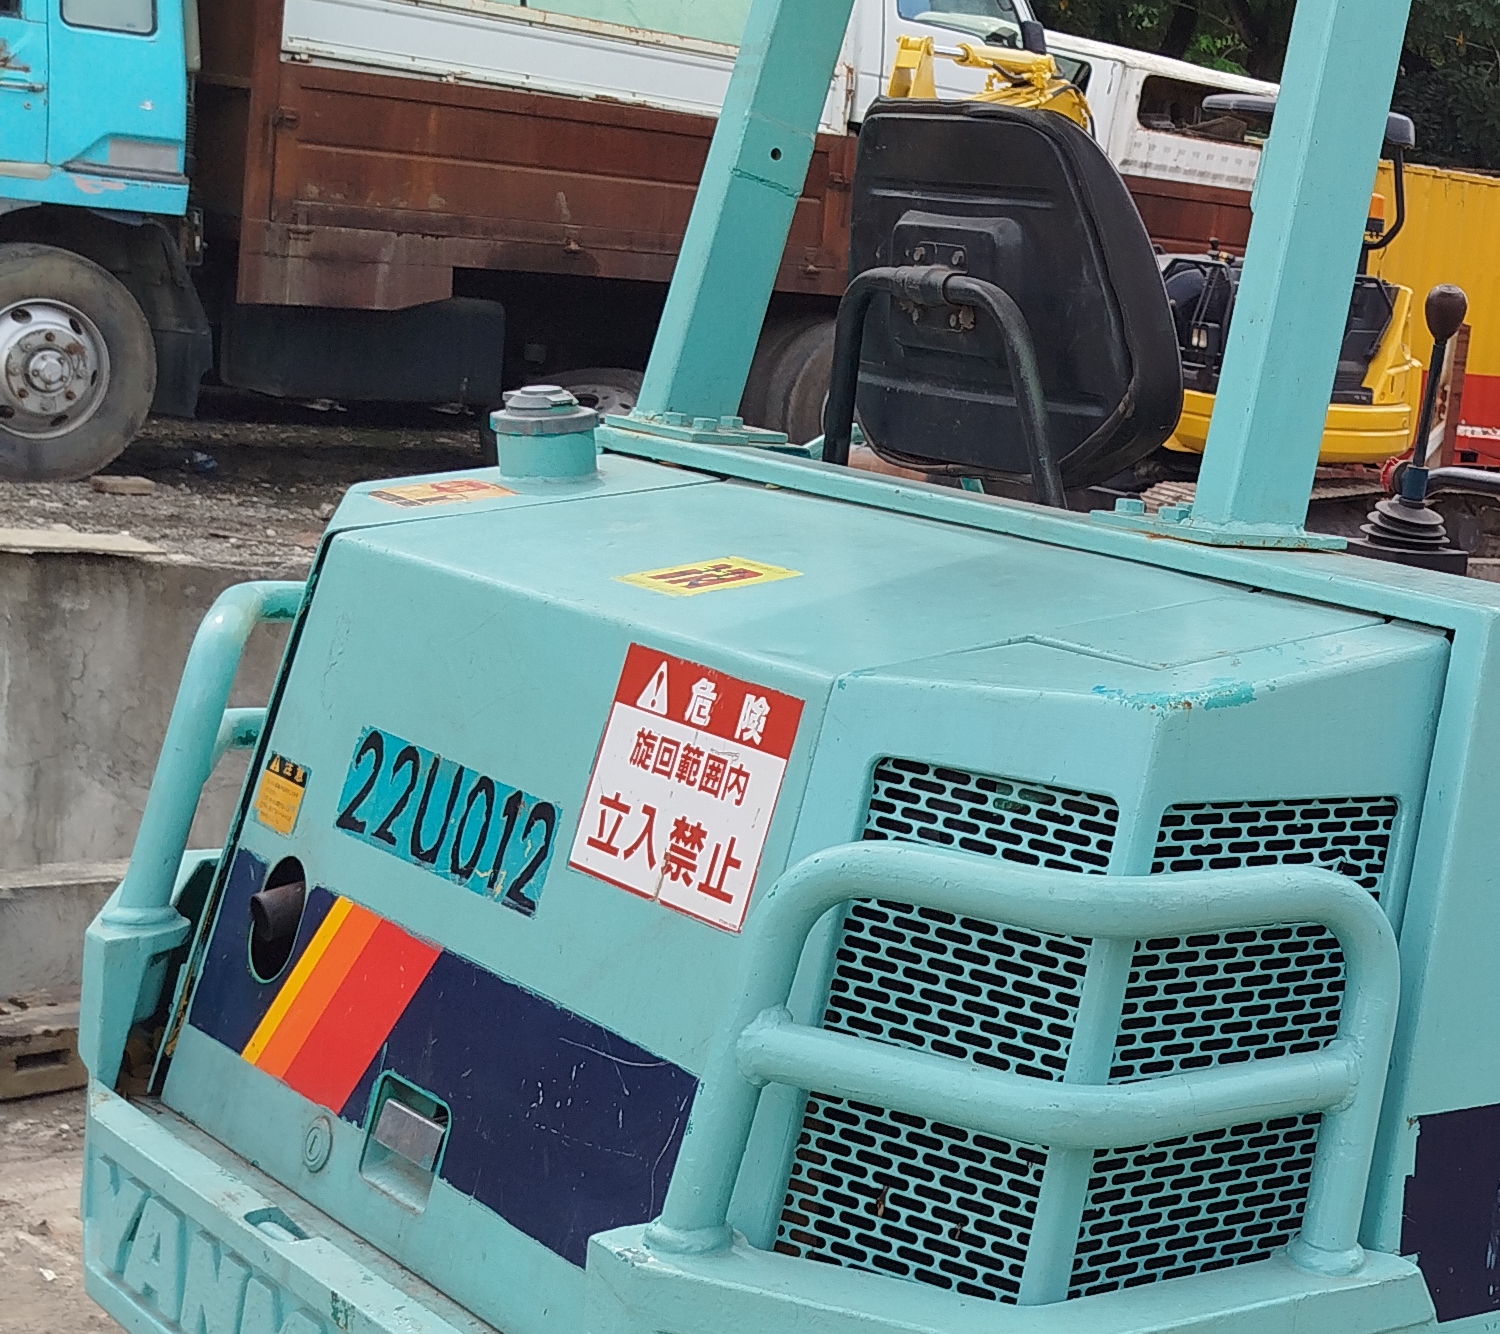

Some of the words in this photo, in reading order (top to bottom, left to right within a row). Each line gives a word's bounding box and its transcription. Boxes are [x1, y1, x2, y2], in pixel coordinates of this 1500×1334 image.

[684, 677, 770, 745] 危険
[629, 727, 751, 806] 旋回範囲内
[336, 730, 556, 916] 22U012
[586, 792, 742, 904] 立入禁止
